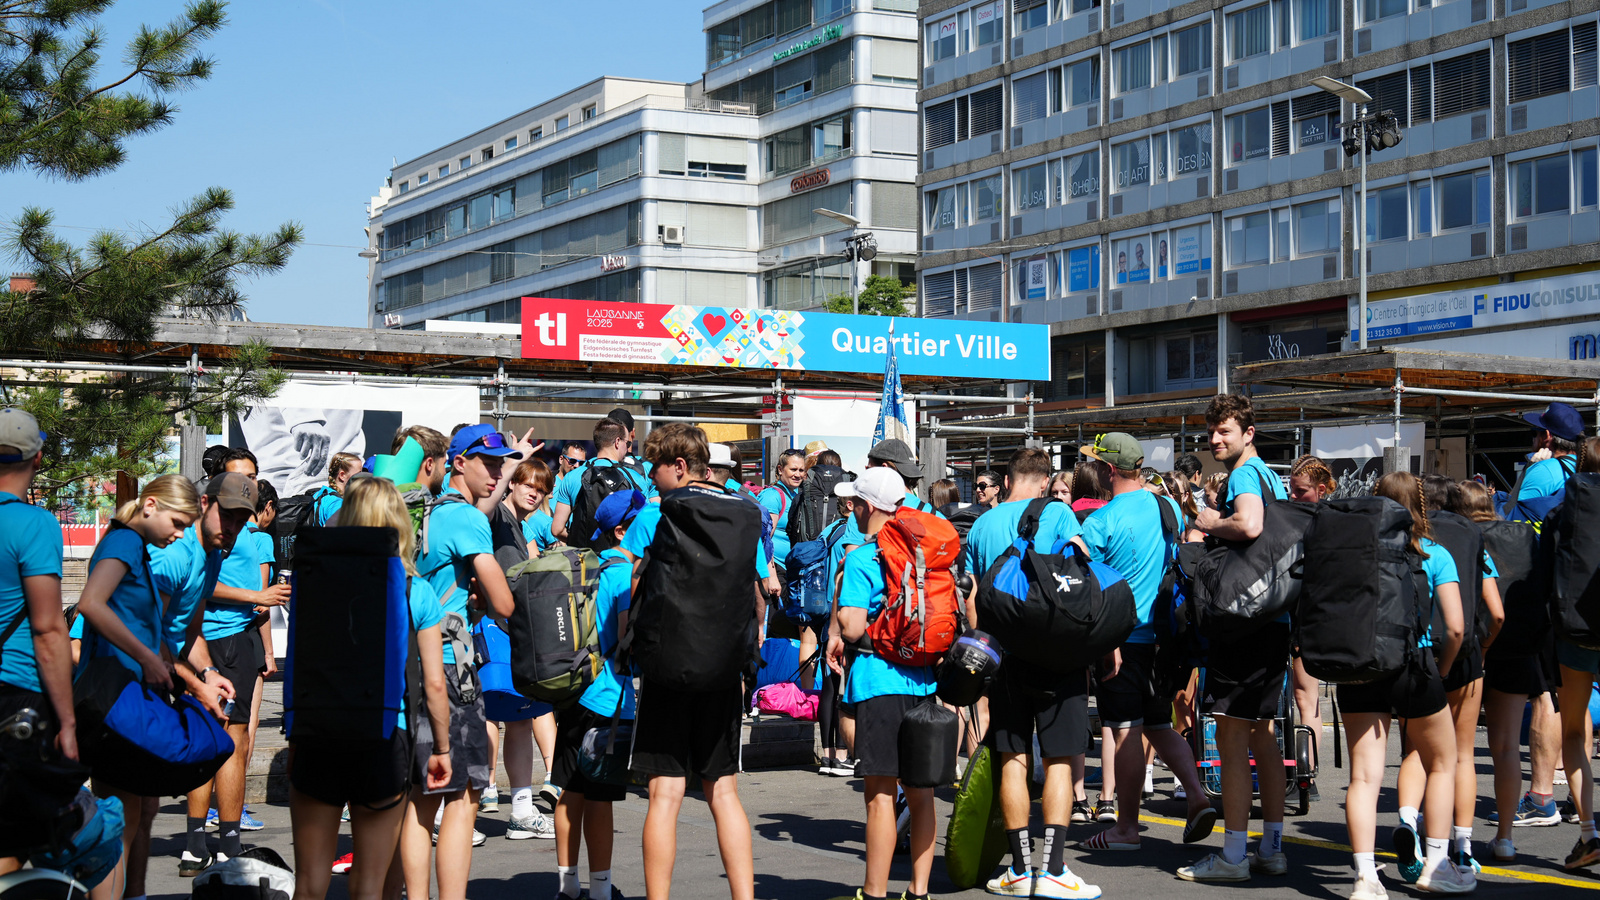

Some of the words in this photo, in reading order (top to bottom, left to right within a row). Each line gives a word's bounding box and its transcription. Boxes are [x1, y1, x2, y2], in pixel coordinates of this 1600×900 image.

[1131, 165, 1149, 182] ART
[1158, 161, 1165, 177] &
[1178, 151, 1212, 172] DESIGN
[586, 308, 645, 320] LAUSANNE
[1374, 307, 1397, 321] Centre
[1399, 301, 1437, 317] Chirurgical
[1439, 300, 1447, 315] de
[1449, 296, 1467, 312] l'Oeil
[534, 312, 567, 346] tl
[586, 318, 613, 328] 2025
[1375, 329, 1385, 337] 312
[1386, 328, 1393, 336] 35
[1394, 327, 1401, 335] 00
[1417, 321, 1457, 332] www.vision.tv
[627, 340, 662, 348] gymnastique
[831, 327, 950, 357] Quartier
[955, 333, 1018, 361] Ville
[1569, 334, 1600, 360] m
[556, 606, 566, 642] FORCLAZ
